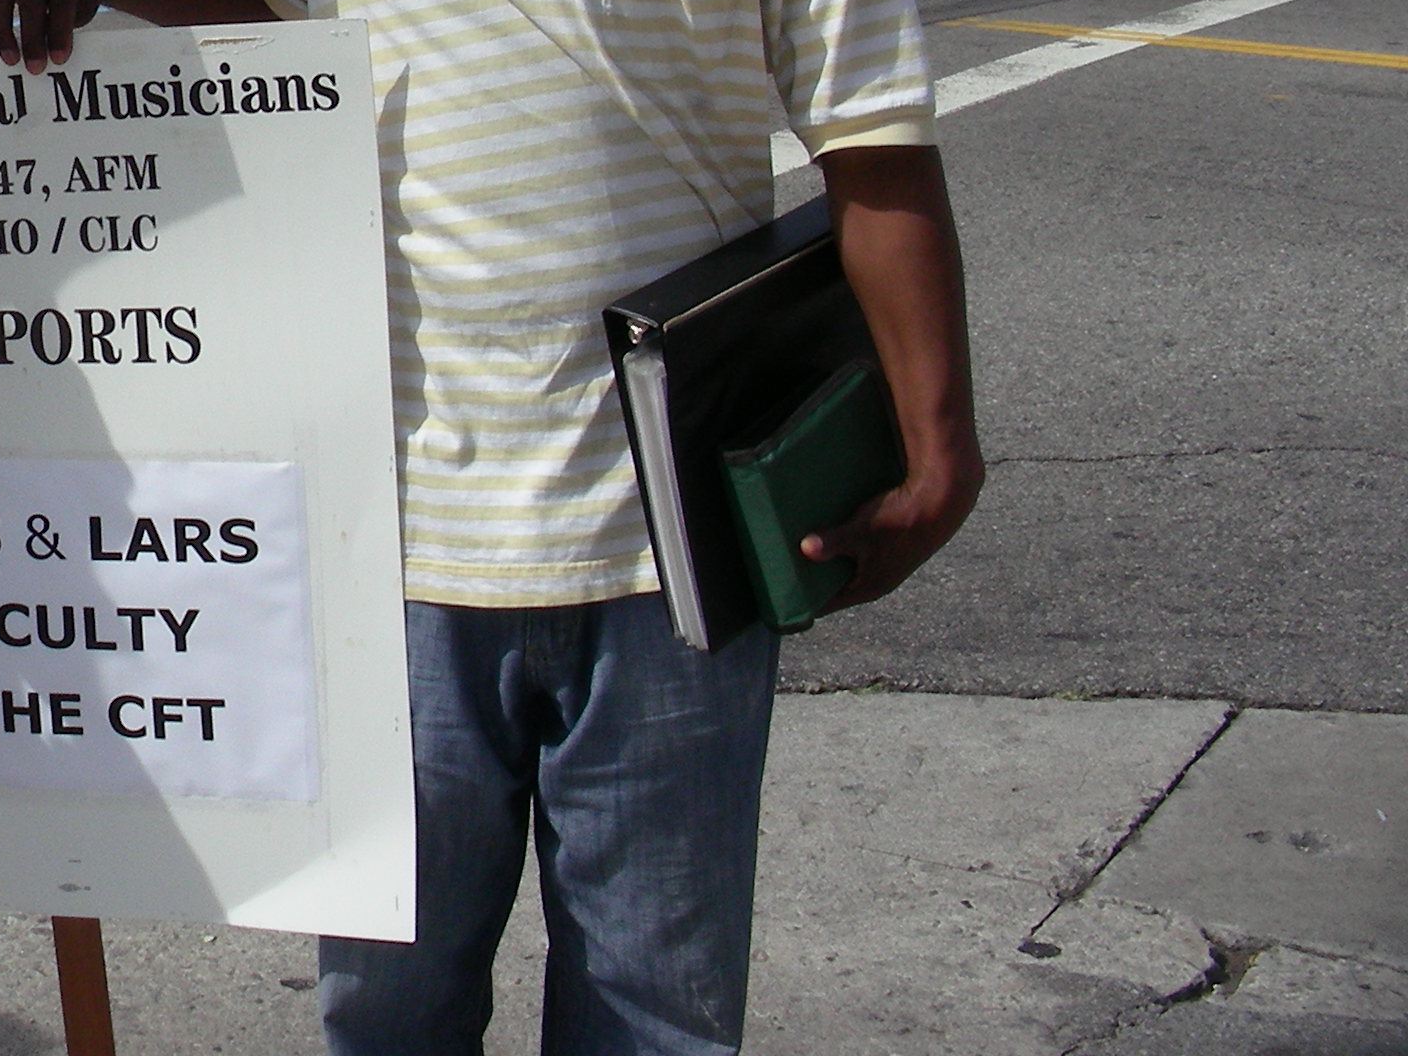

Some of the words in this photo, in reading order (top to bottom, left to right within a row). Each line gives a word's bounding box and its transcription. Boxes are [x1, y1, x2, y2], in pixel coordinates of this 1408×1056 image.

[47, 61, 341, 123] Musicians
[64, 153, 161, 193] AFM
[79, 213, 159, 254] CLC
[25, 513, 67, 560] &
[88, 515, 260, 564] LARS
[107, 694, 226, 741] CFT
